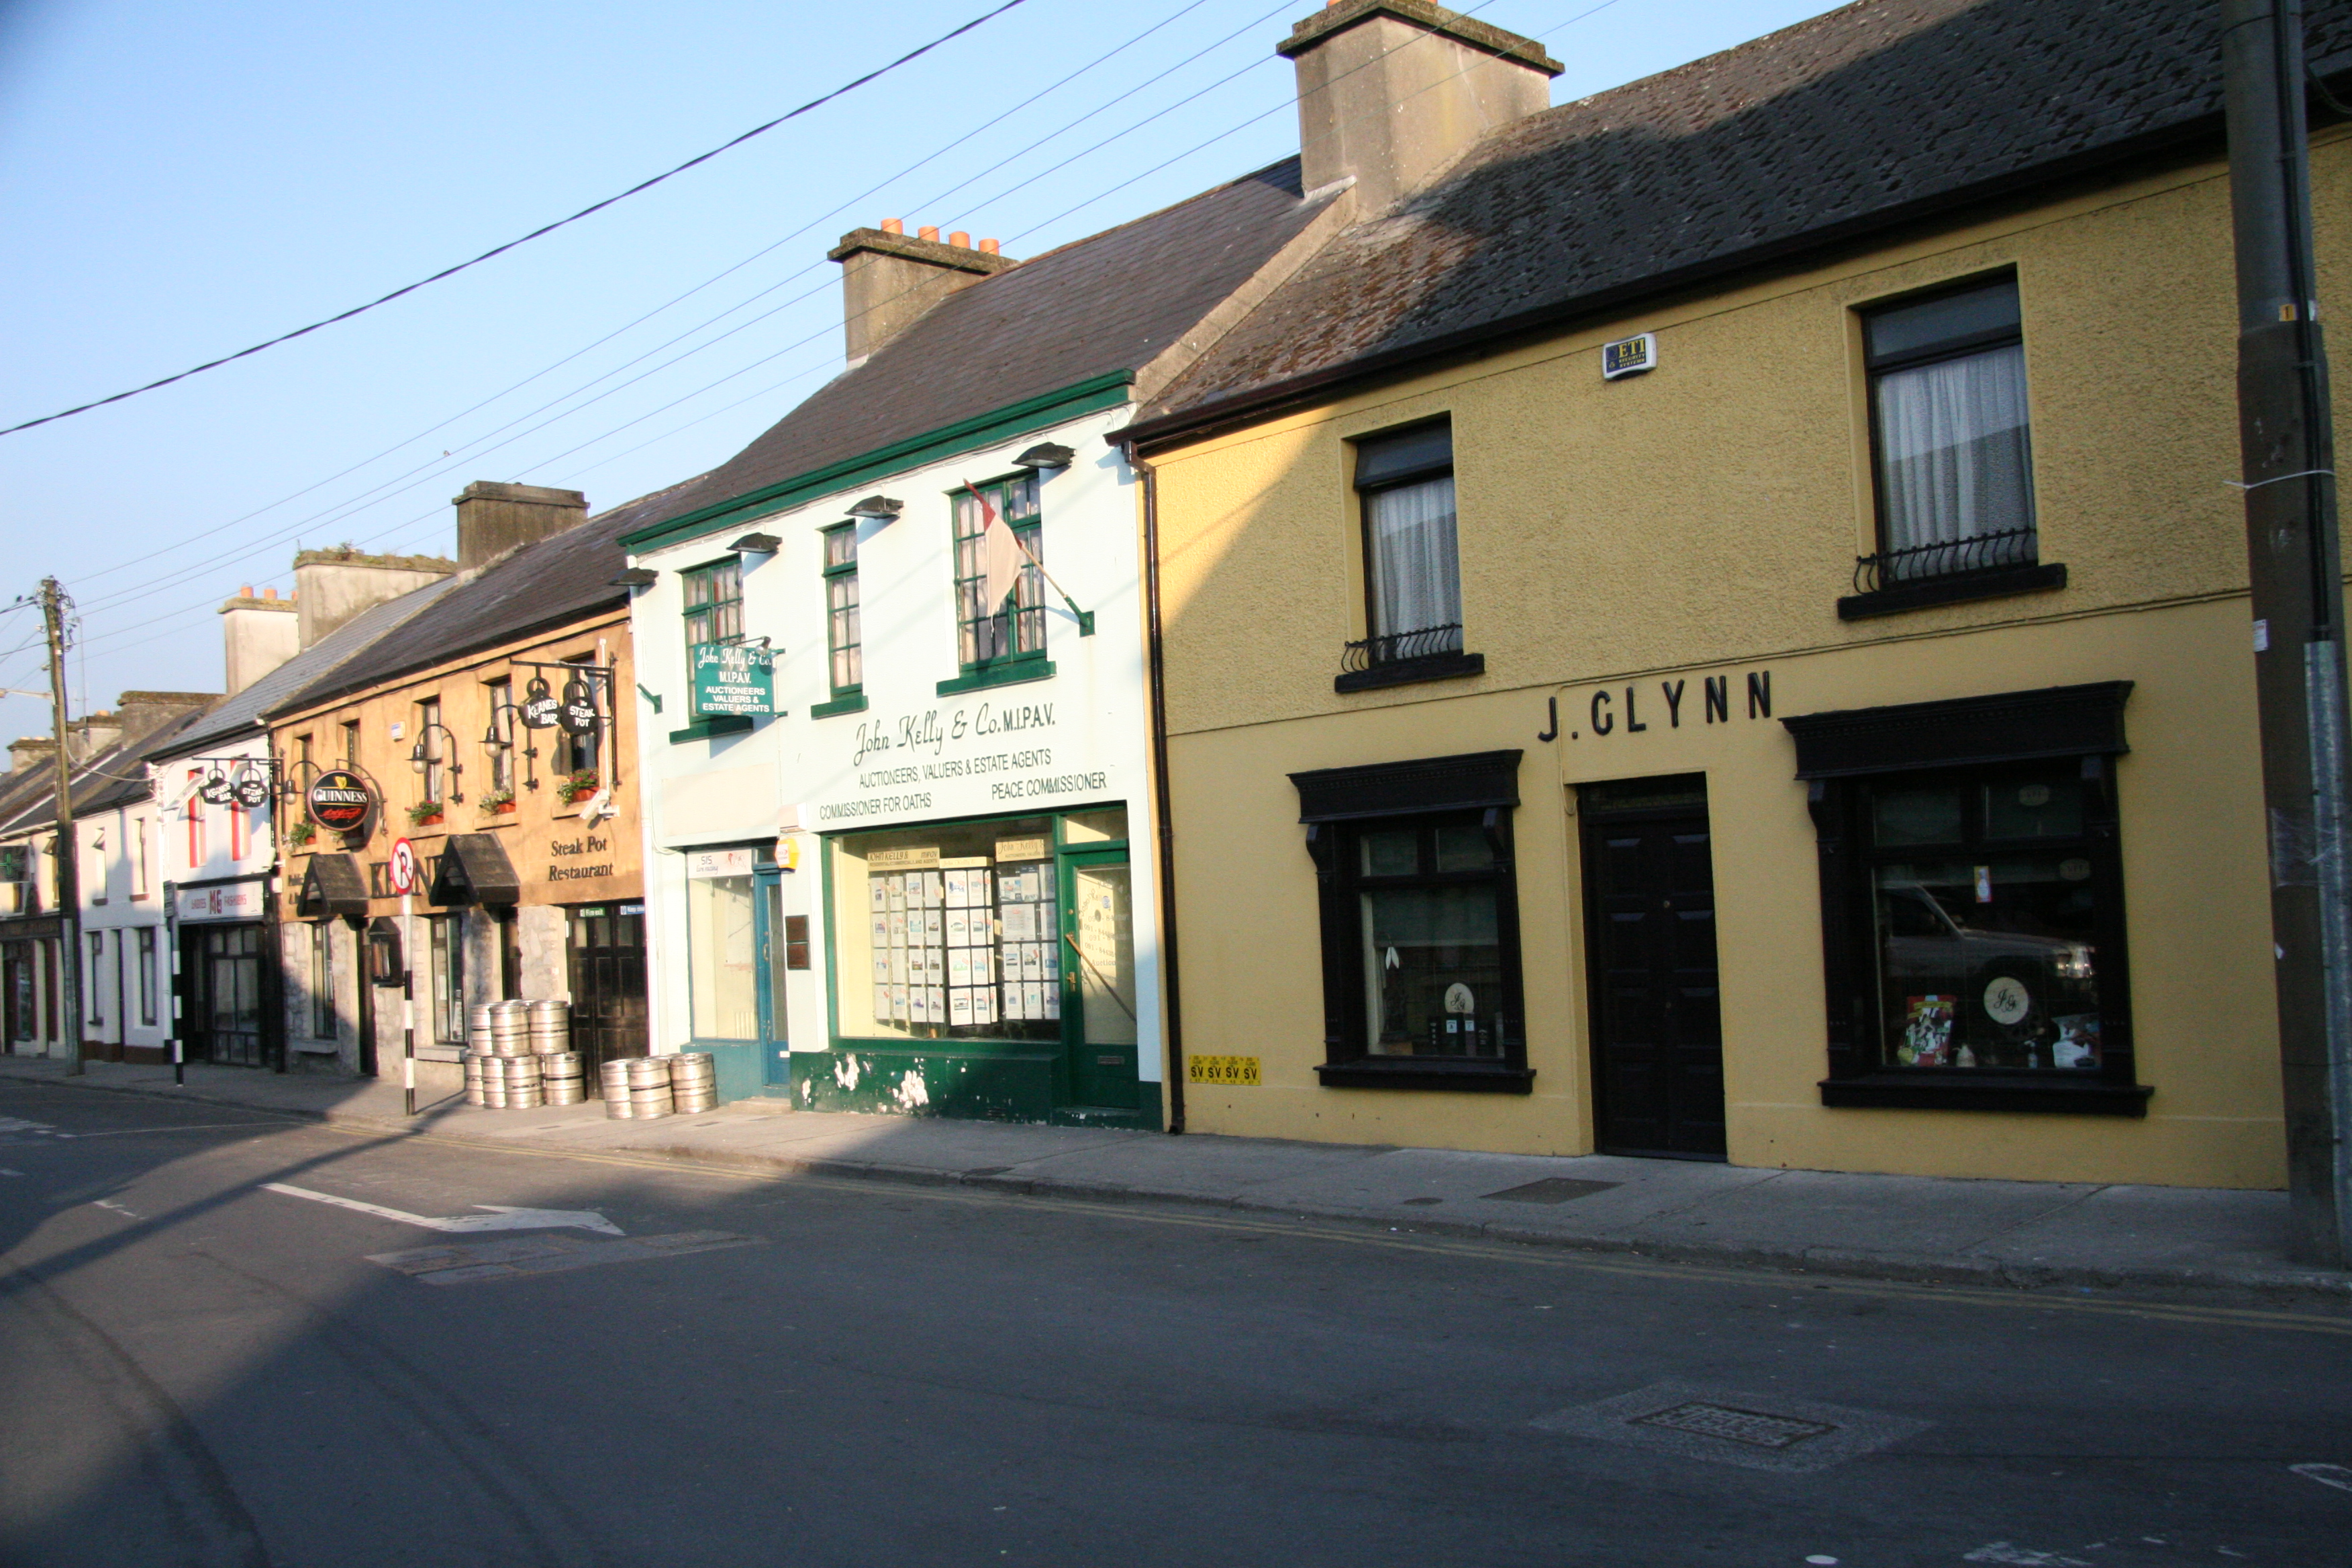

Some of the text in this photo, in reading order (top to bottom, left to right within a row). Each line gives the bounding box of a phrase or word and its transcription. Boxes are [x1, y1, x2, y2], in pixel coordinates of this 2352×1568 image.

[1618, 339, 1645, 358] ETI
[698, 646, 719, 669] John
[721, 648, 745, 671] Kelly
[748, 650, 756, 665] &
[705, 686, 766, 695] AUCTIONEERS
[713, 695, 751, 703] VALUERS
[569, 705, 595, 718] STEAK
[702, 703, 770, 712] ESTATE AGENTS
[540, 713, 558, 725] BAR
[575, 718, 590, 727] POT
[853, 719, 889, 767] John
[897, 709, 943, 756] Kelly
[951, 710, 968, 739] &
[976, 702, 1001, 735] Co.
[859, 748, 1051, 789] AUCTIONEERS, VALUERS & ESTATE AGENTS
[242, 787, 265, 796] STEAK
[991, 771, 1107, 800] PEACE COMMISSIONER
[219, 792, 233, 801] BAR
[313, 789, 368, 803] GUINNESS
[820, 792, 932, 820] COMMISSIONER FOR OATHS
[551, 836, 608, 856] Steak Pot
[885, 851, 903, 861] KELLY
[548, 862, 614, 881] Restaurant
